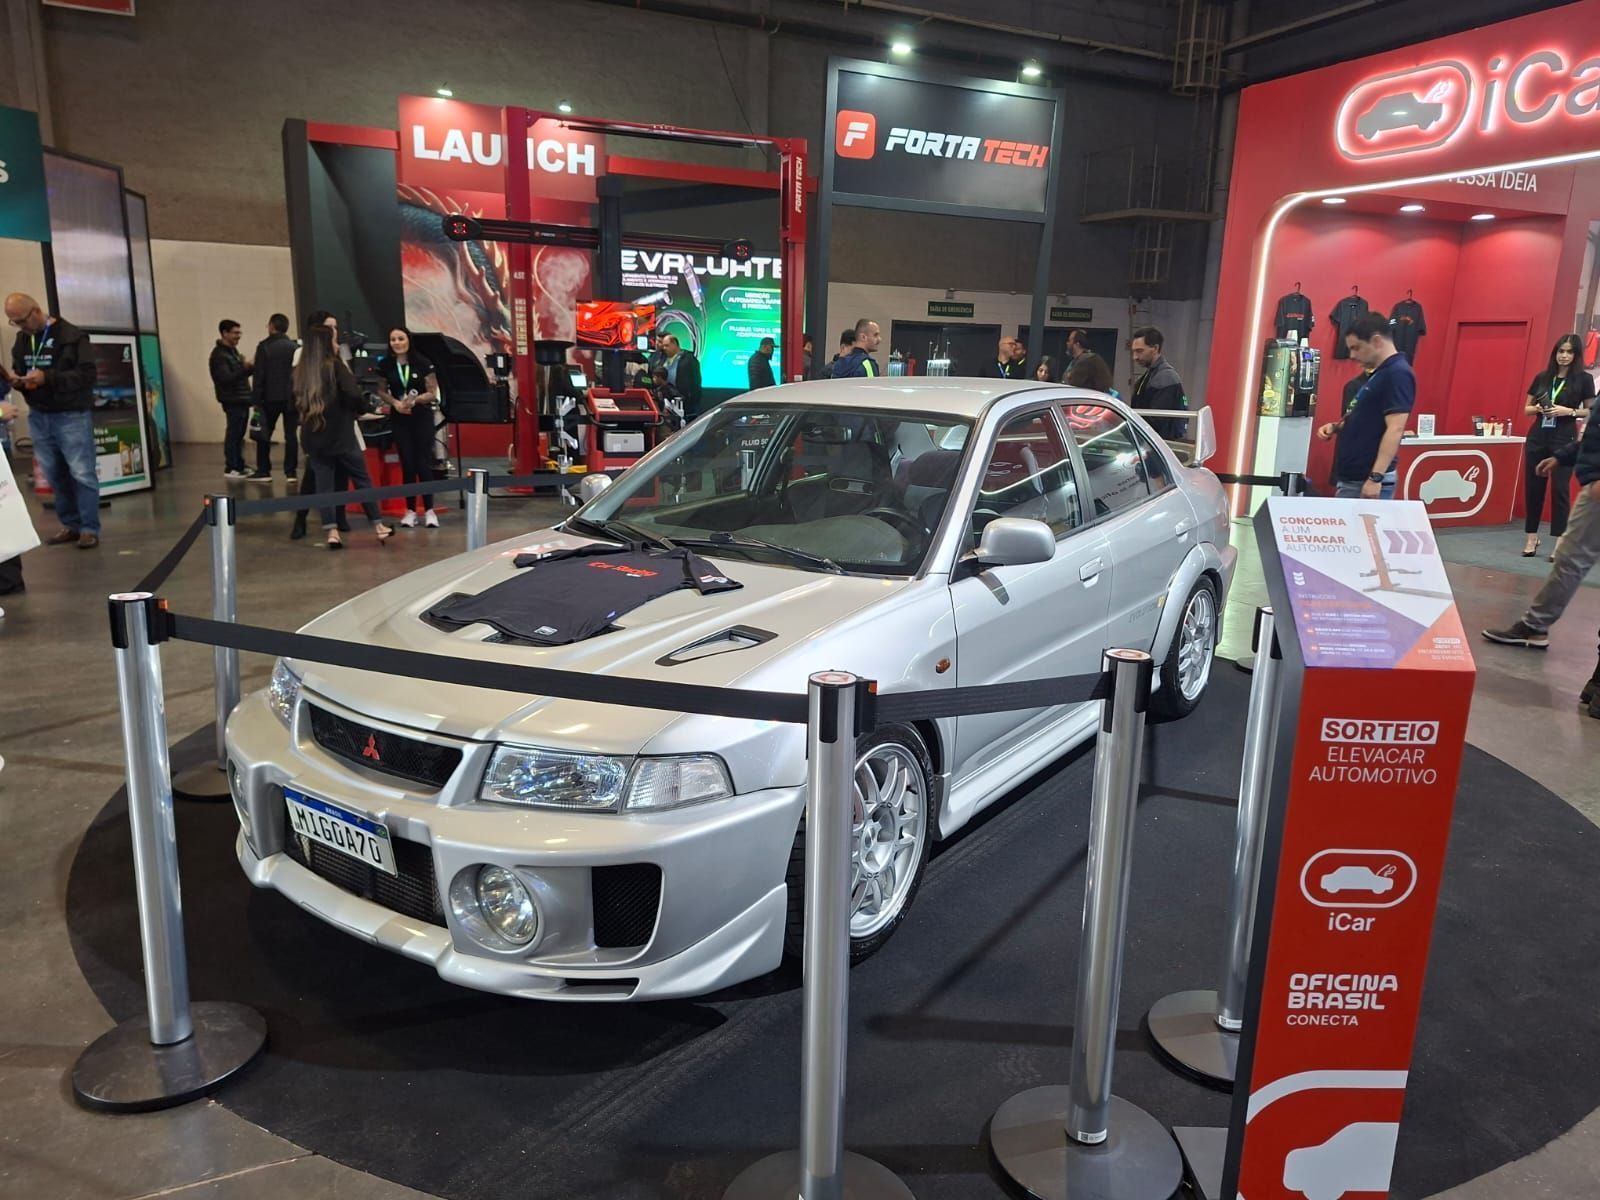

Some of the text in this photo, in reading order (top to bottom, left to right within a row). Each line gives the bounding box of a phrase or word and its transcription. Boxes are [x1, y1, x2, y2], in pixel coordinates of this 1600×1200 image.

[412, 125, 595, 176] LAUCH
[885, 127, 1049, 168] FORTA TECH
[1448, 170, 1537, 192] SSA IDEIA
[1279, 516, 1347, 527] CONCORRA
[1281, 526, 1311, 534] A UM
[1283, 535, 1345, 544] ELEVACAR
[1286, 544, 1362, 554] AUTOMOTIVO
[1324, 721, 1436, 743] SORTEIO
[1327, 746, 1425, 765] ELEVACAR
[1308, 766, 1437, 785] AUTOMOTIVO
[1328, 912, 1376, 932] iCar
[1289, 973, 1398, 992] OFICINA
[1287, 992, 1385, 1010] BRASIL
[1286, 1014, 1359, 1026] CONECTA
